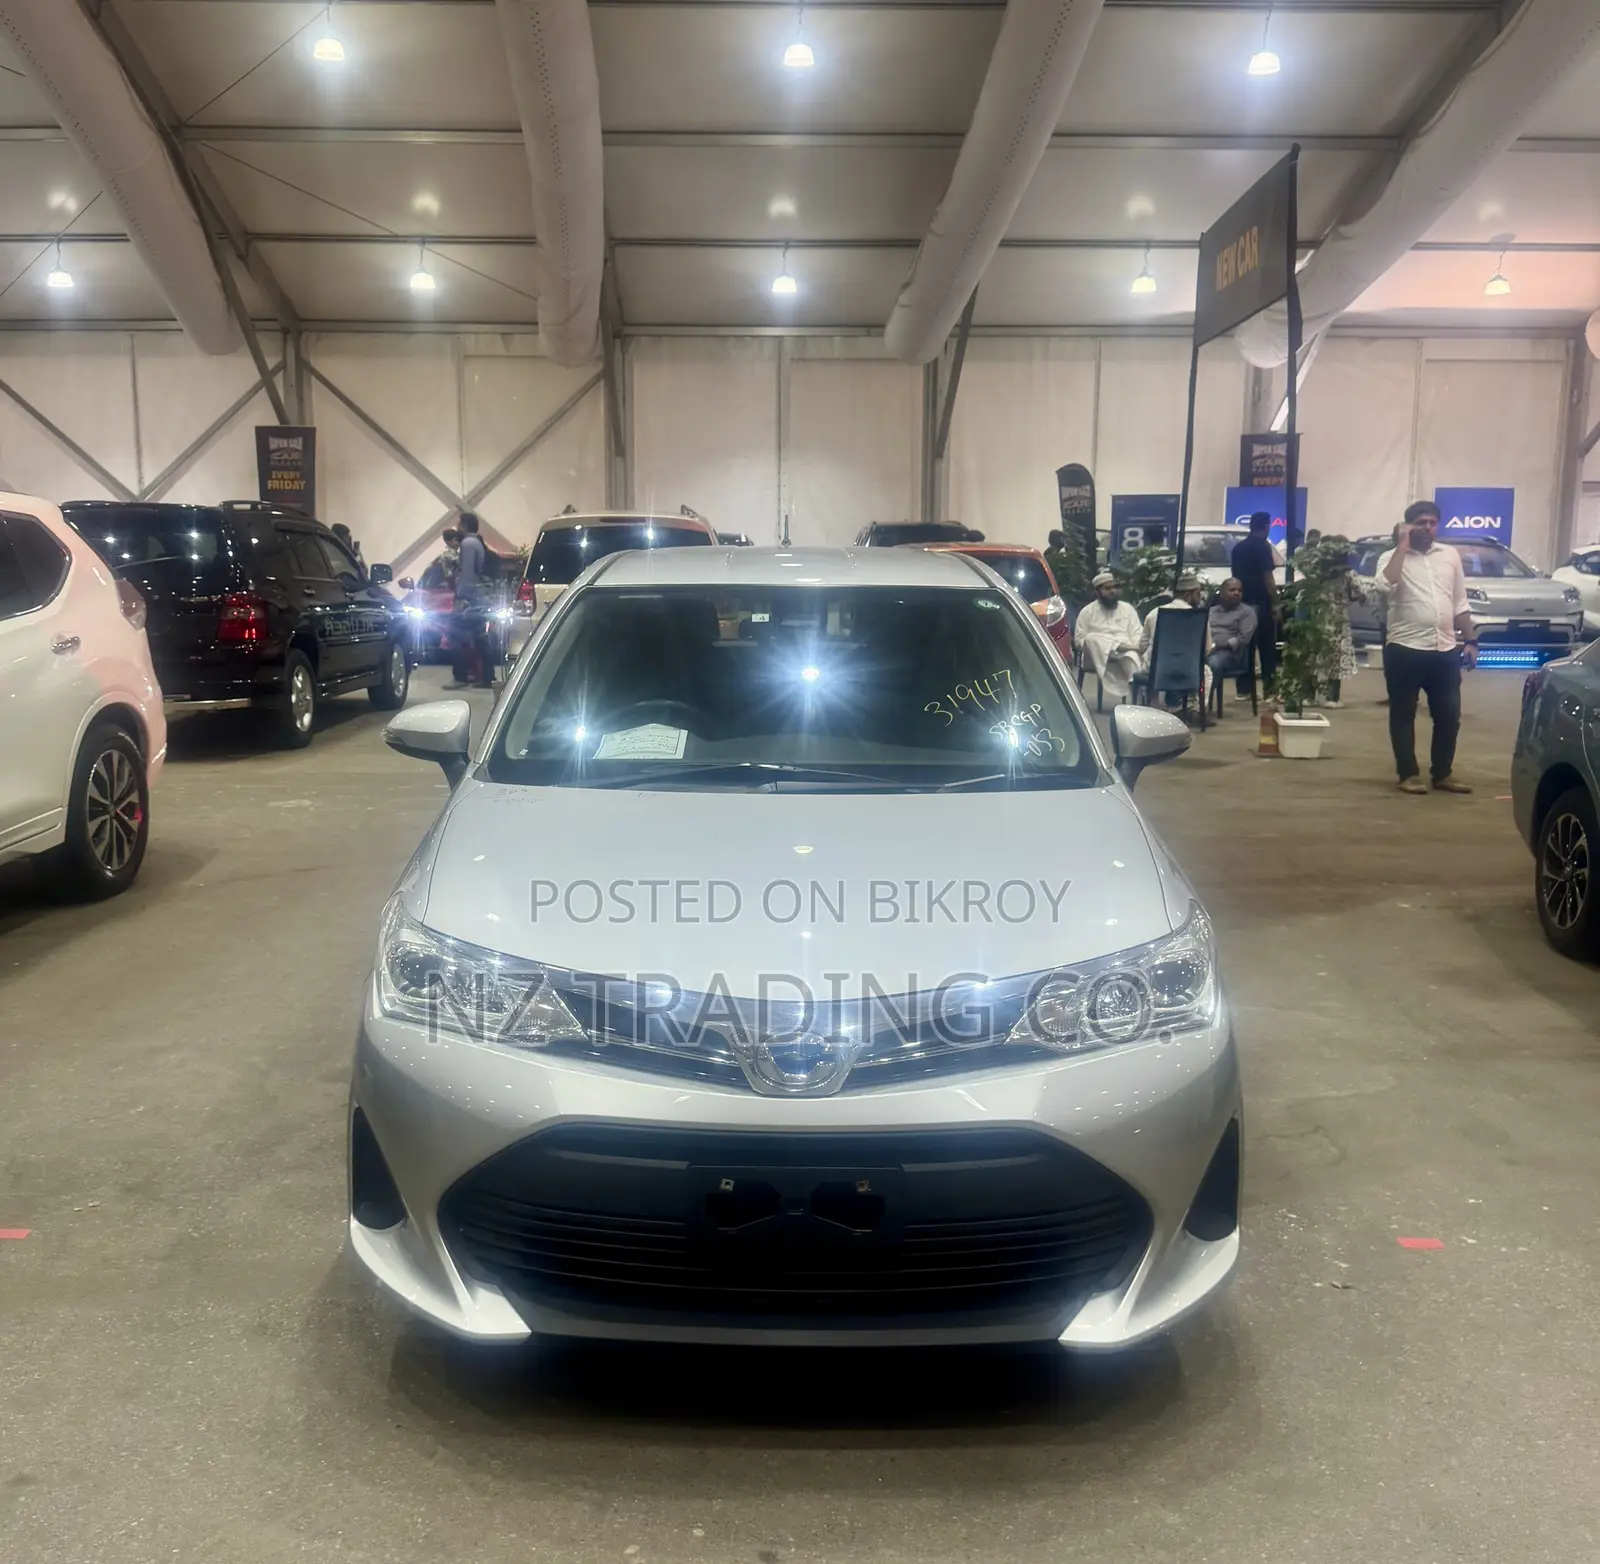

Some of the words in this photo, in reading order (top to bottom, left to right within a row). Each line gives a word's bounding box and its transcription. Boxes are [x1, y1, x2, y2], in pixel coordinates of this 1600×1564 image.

[1216, 241, 1237, 293] NEW
[1237, 226, 1259, 278] CAR
[267, 479, 306, 490] FRIDAY
[1253, 476, 1285, 486] EVERY
[1445, 516, 1501, 529] AION
[924, 669, 1018, 728] 31947
